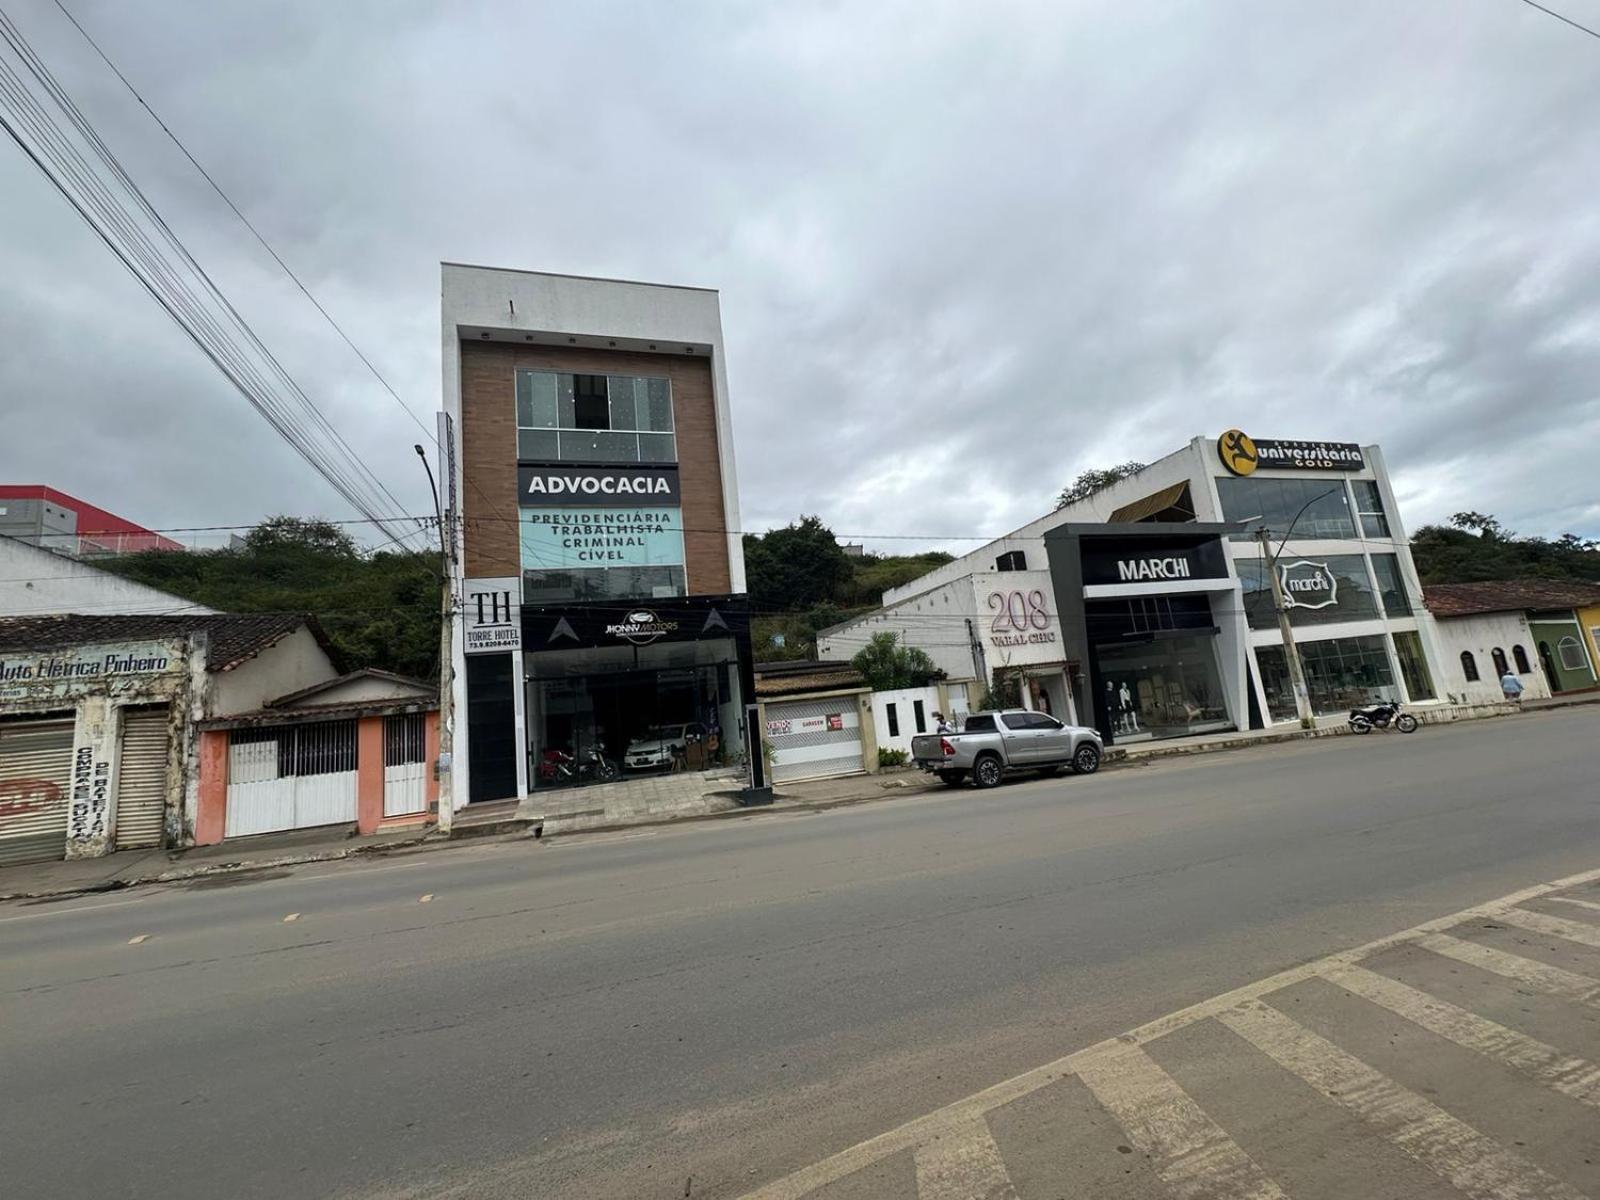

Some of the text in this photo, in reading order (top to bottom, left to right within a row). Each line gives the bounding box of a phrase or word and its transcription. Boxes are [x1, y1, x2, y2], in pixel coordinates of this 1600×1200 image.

[528, 476, 671, 494] ADVOCACIA
[531, 511, 671, 524] PREVIDENCIÁRIA
[551, 524, 664, 535] TRABALHISTA
[563, 537, 645, 548] CRIMINAL
[578, 549, 624, 560] CÍVEL
[1117, 558, 1191, 580] MARCHI
[470, 591, 512, 624] TH
[988, 590, 1050, 633] 208
[467, 629, 519, 642] TORRE HOTEL
[104, 652, 168, 673] Pinheiro
